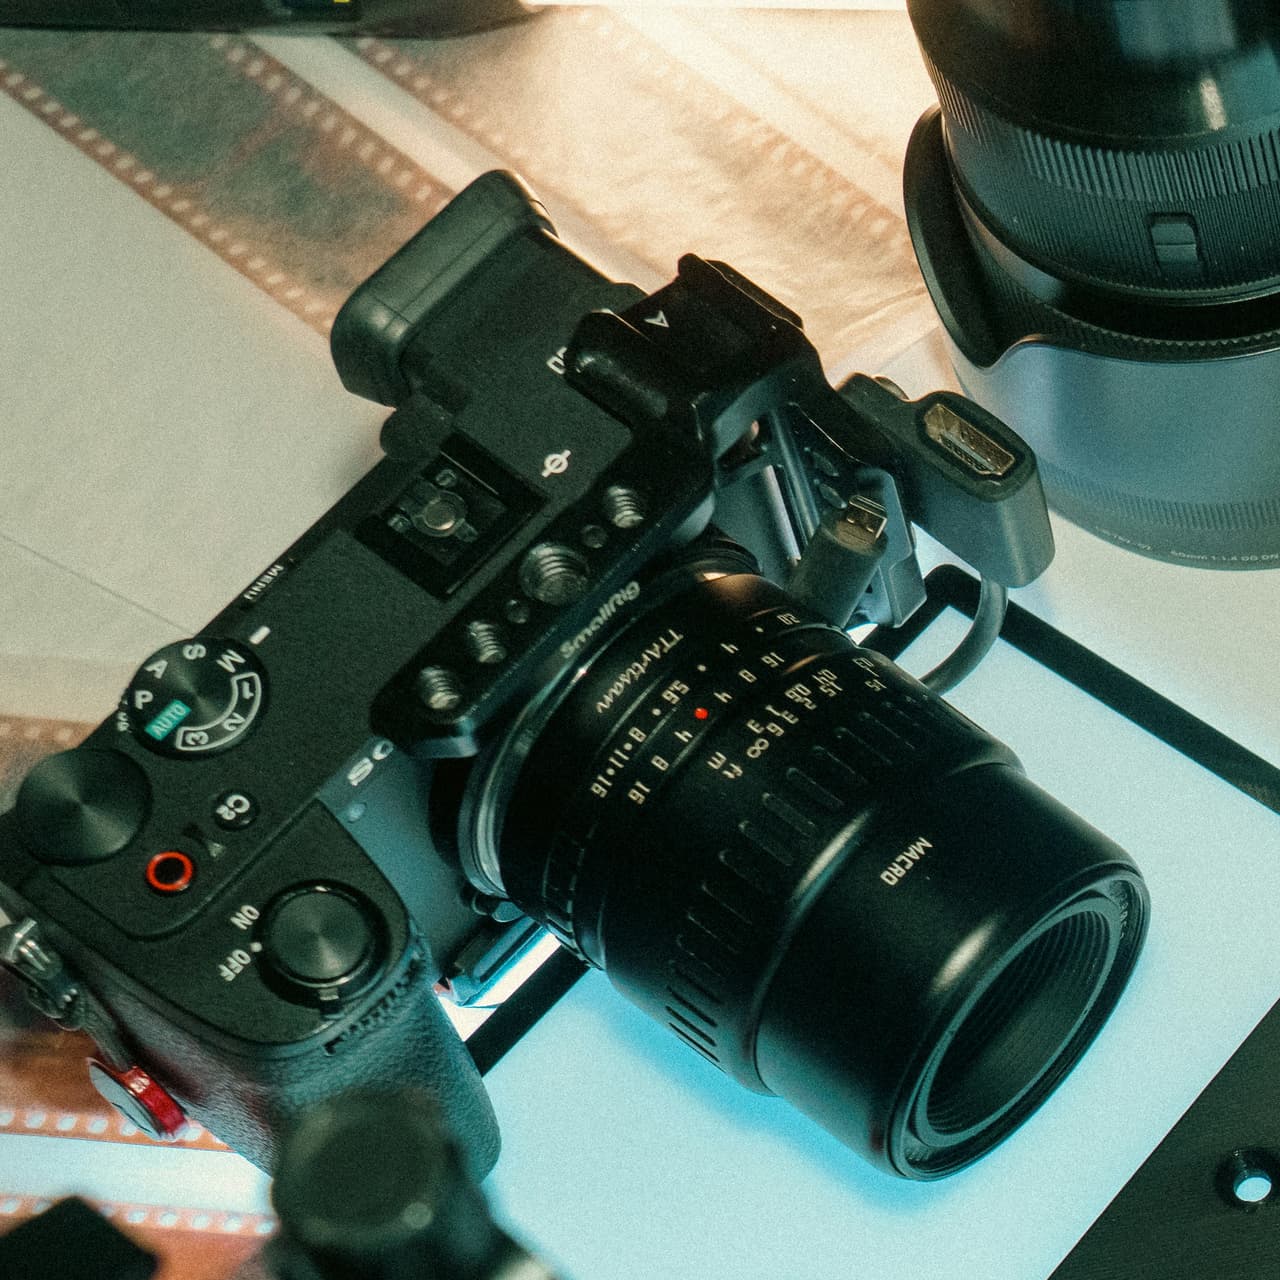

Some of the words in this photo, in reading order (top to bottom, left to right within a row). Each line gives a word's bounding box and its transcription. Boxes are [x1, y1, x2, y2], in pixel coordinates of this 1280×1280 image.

[243, 565, 284, 600] MENU
[560, 581, 641, 658] SmallRig
[182, 644, 207, 660] S
[216, 649, 246, 674] M
[145, 660, 168, 679] A
[596, 628, 684, 713] TTArtisan
[135, 690, 154, 709] P
[241, 681, 254, 699] 1
[662, 680, 690, 704] 5.6
[152, 704, 187, 736] AUTO
[223, 712, 247, 732] 2
[628, 780, 651, 805] 16
[761, 652, 785, 668] 16
[185, 731, 209, 746] 3
[880, 836, 933, 886] MACRO
[230, 905, 260, 930] ON
[219, 949, 251, 981] OFF
